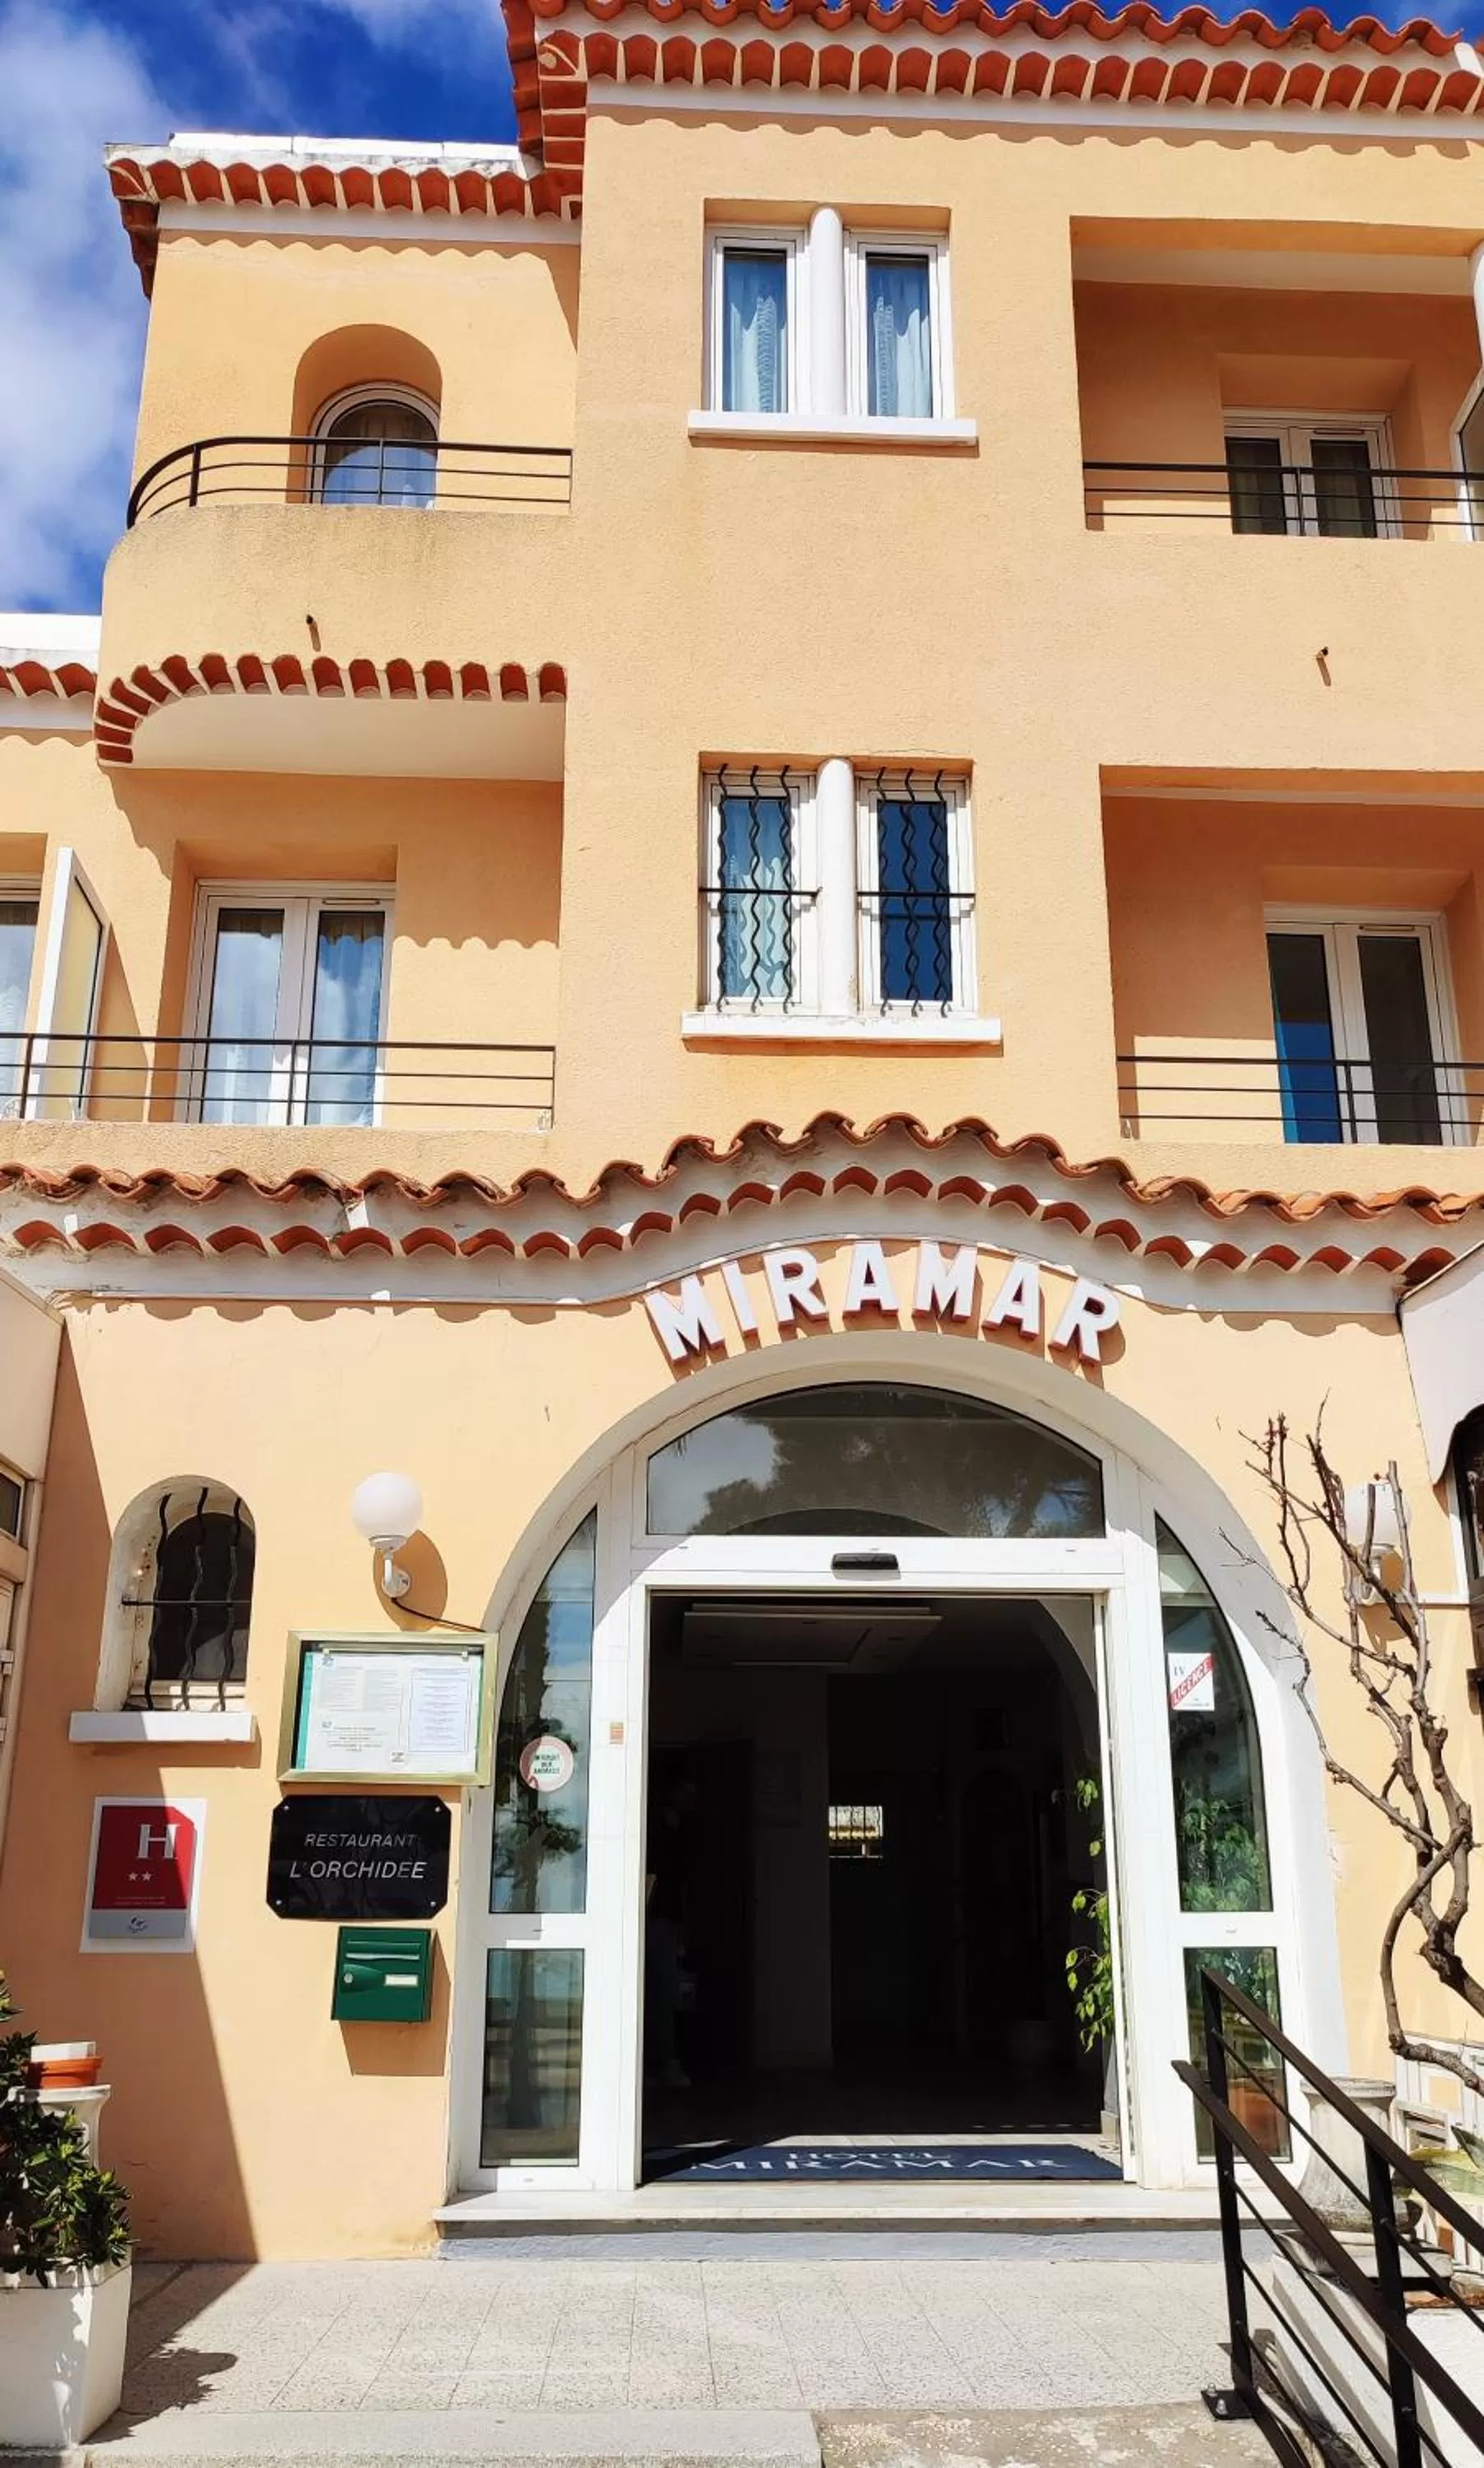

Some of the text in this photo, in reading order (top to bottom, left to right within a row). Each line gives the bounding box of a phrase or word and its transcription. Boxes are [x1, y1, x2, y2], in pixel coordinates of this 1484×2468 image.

[643, 1238, 1121, 1364] MIRAMAR
[1173, 1658, 1212, 1705] LICENCE
[137, 1824, 181, 1859] H
[304, 1834, 417, 1847] RESTAURANT
[692, 2160, 1068, 2169] MIRAMAR
